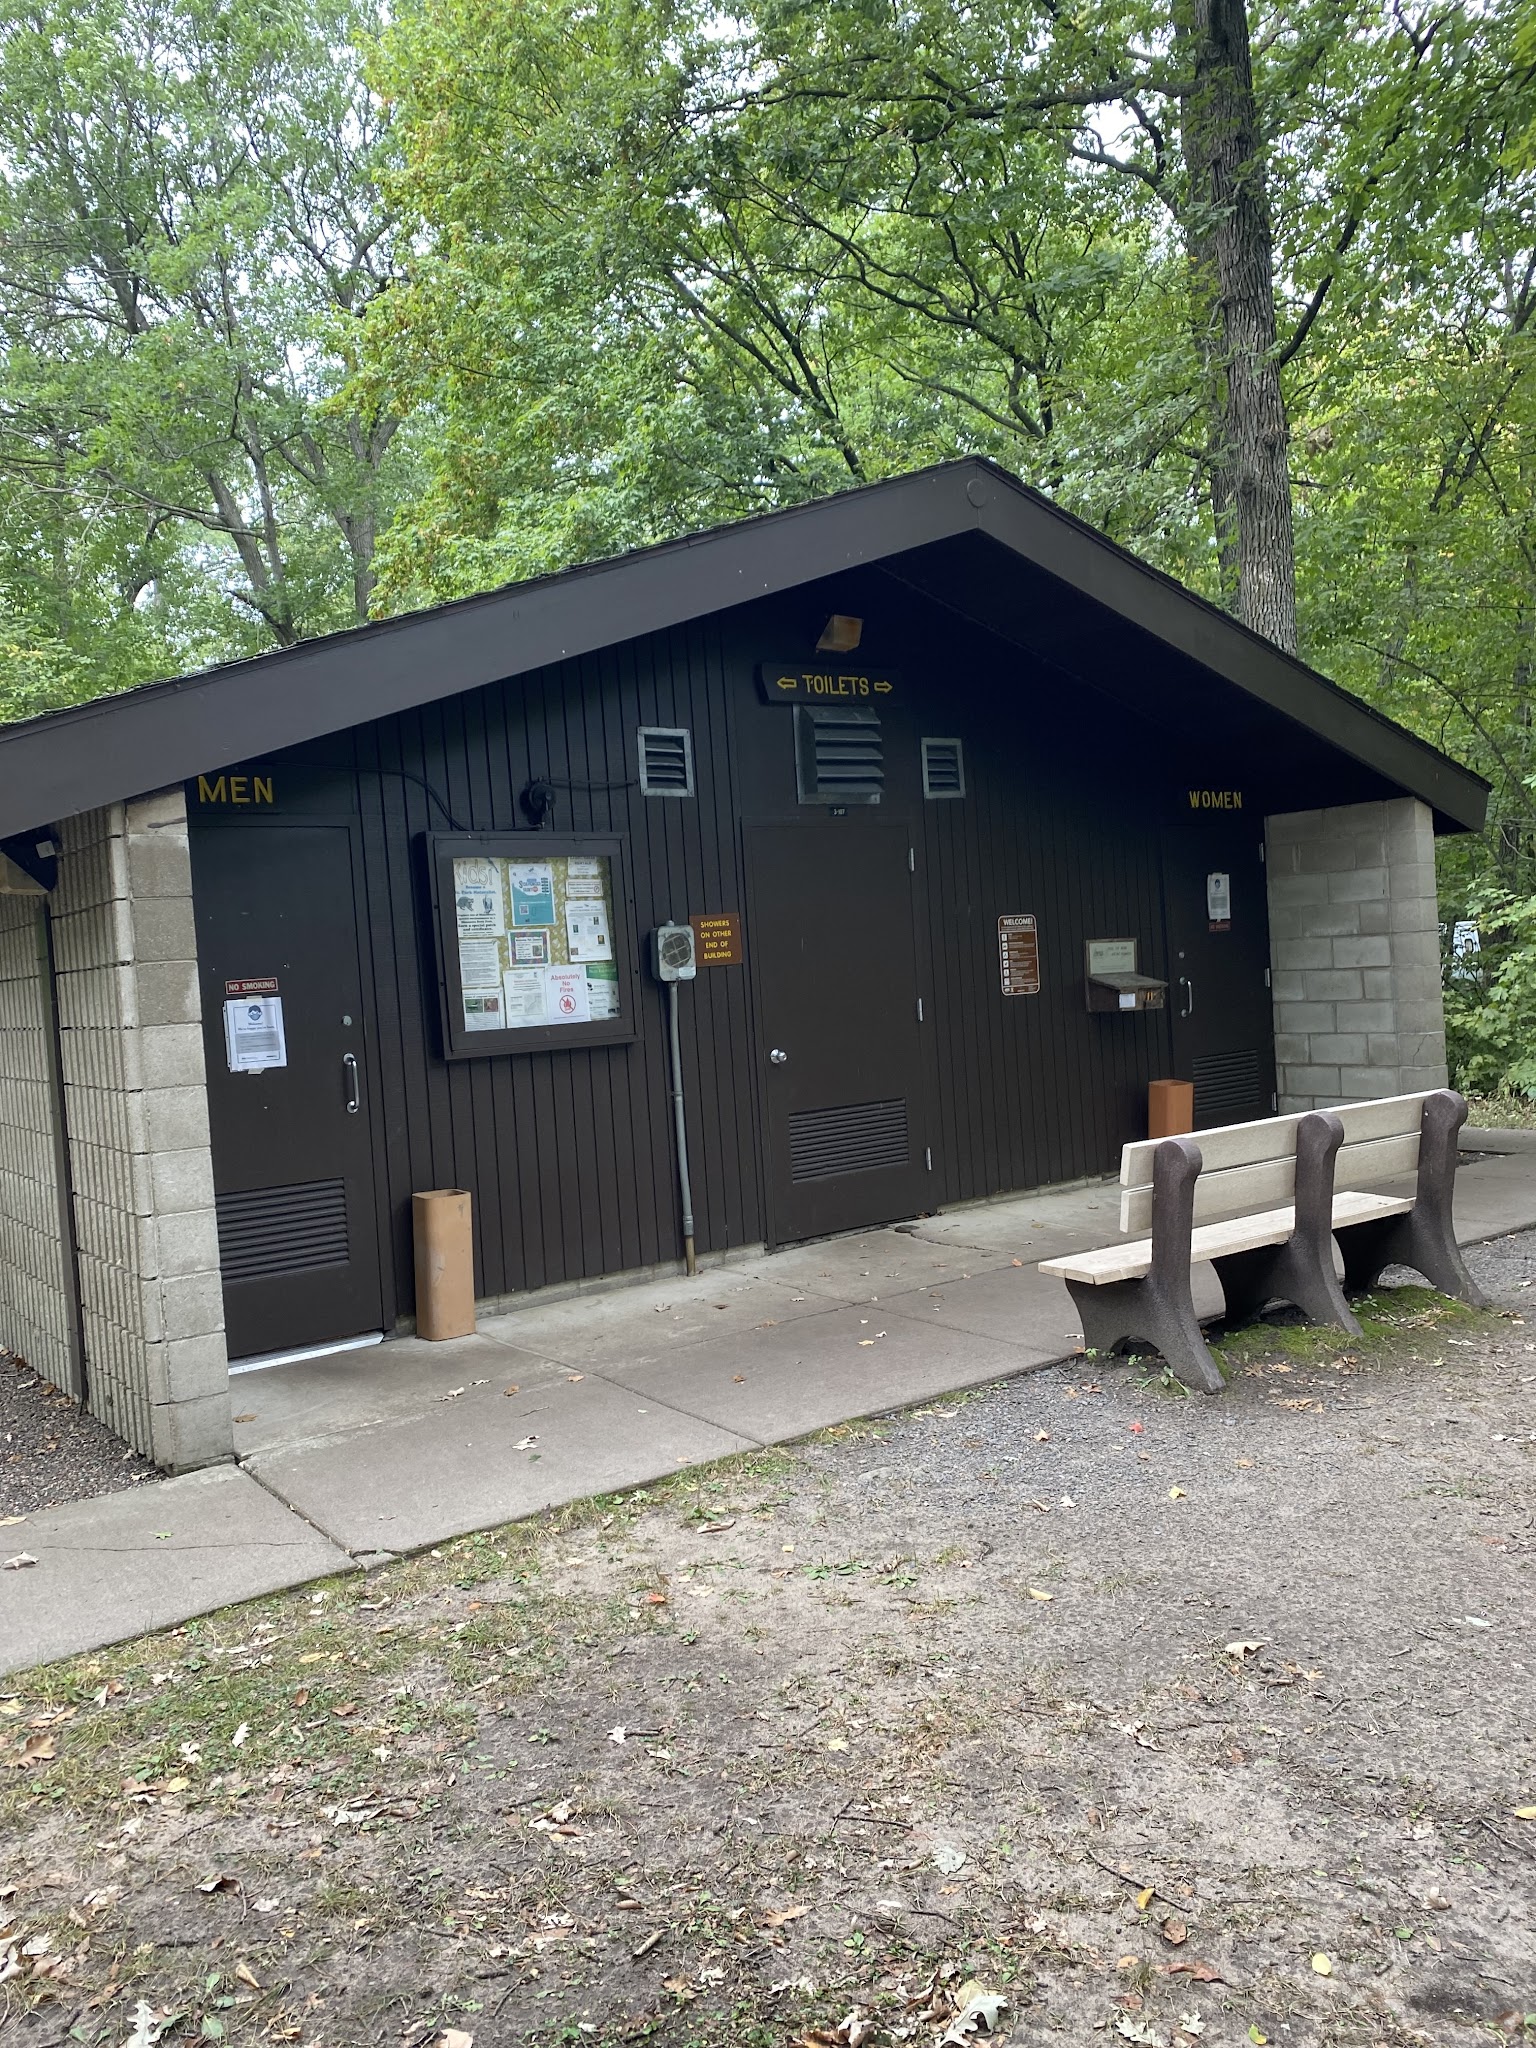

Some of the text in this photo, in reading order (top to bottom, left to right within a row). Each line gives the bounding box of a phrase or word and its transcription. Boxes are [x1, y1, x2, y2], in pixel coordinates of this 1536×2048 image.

[801, 674, 870, 695] TOILETS
[197, 775, 274, 804] MEN
[1189, 790, 1243, 809] WOMEN
[700, 920, 730, 928] SHOWERS
[1003, 917, 1033, 926] WELCOME!
[712, 930, 732, 938] OTHER
[720, 940, 729, 948] OF
[703, 951, 732, 959] BUILDING
[550, 973, 581, 981] Absolutely
[241, 981, 275, 990] SMOKING
